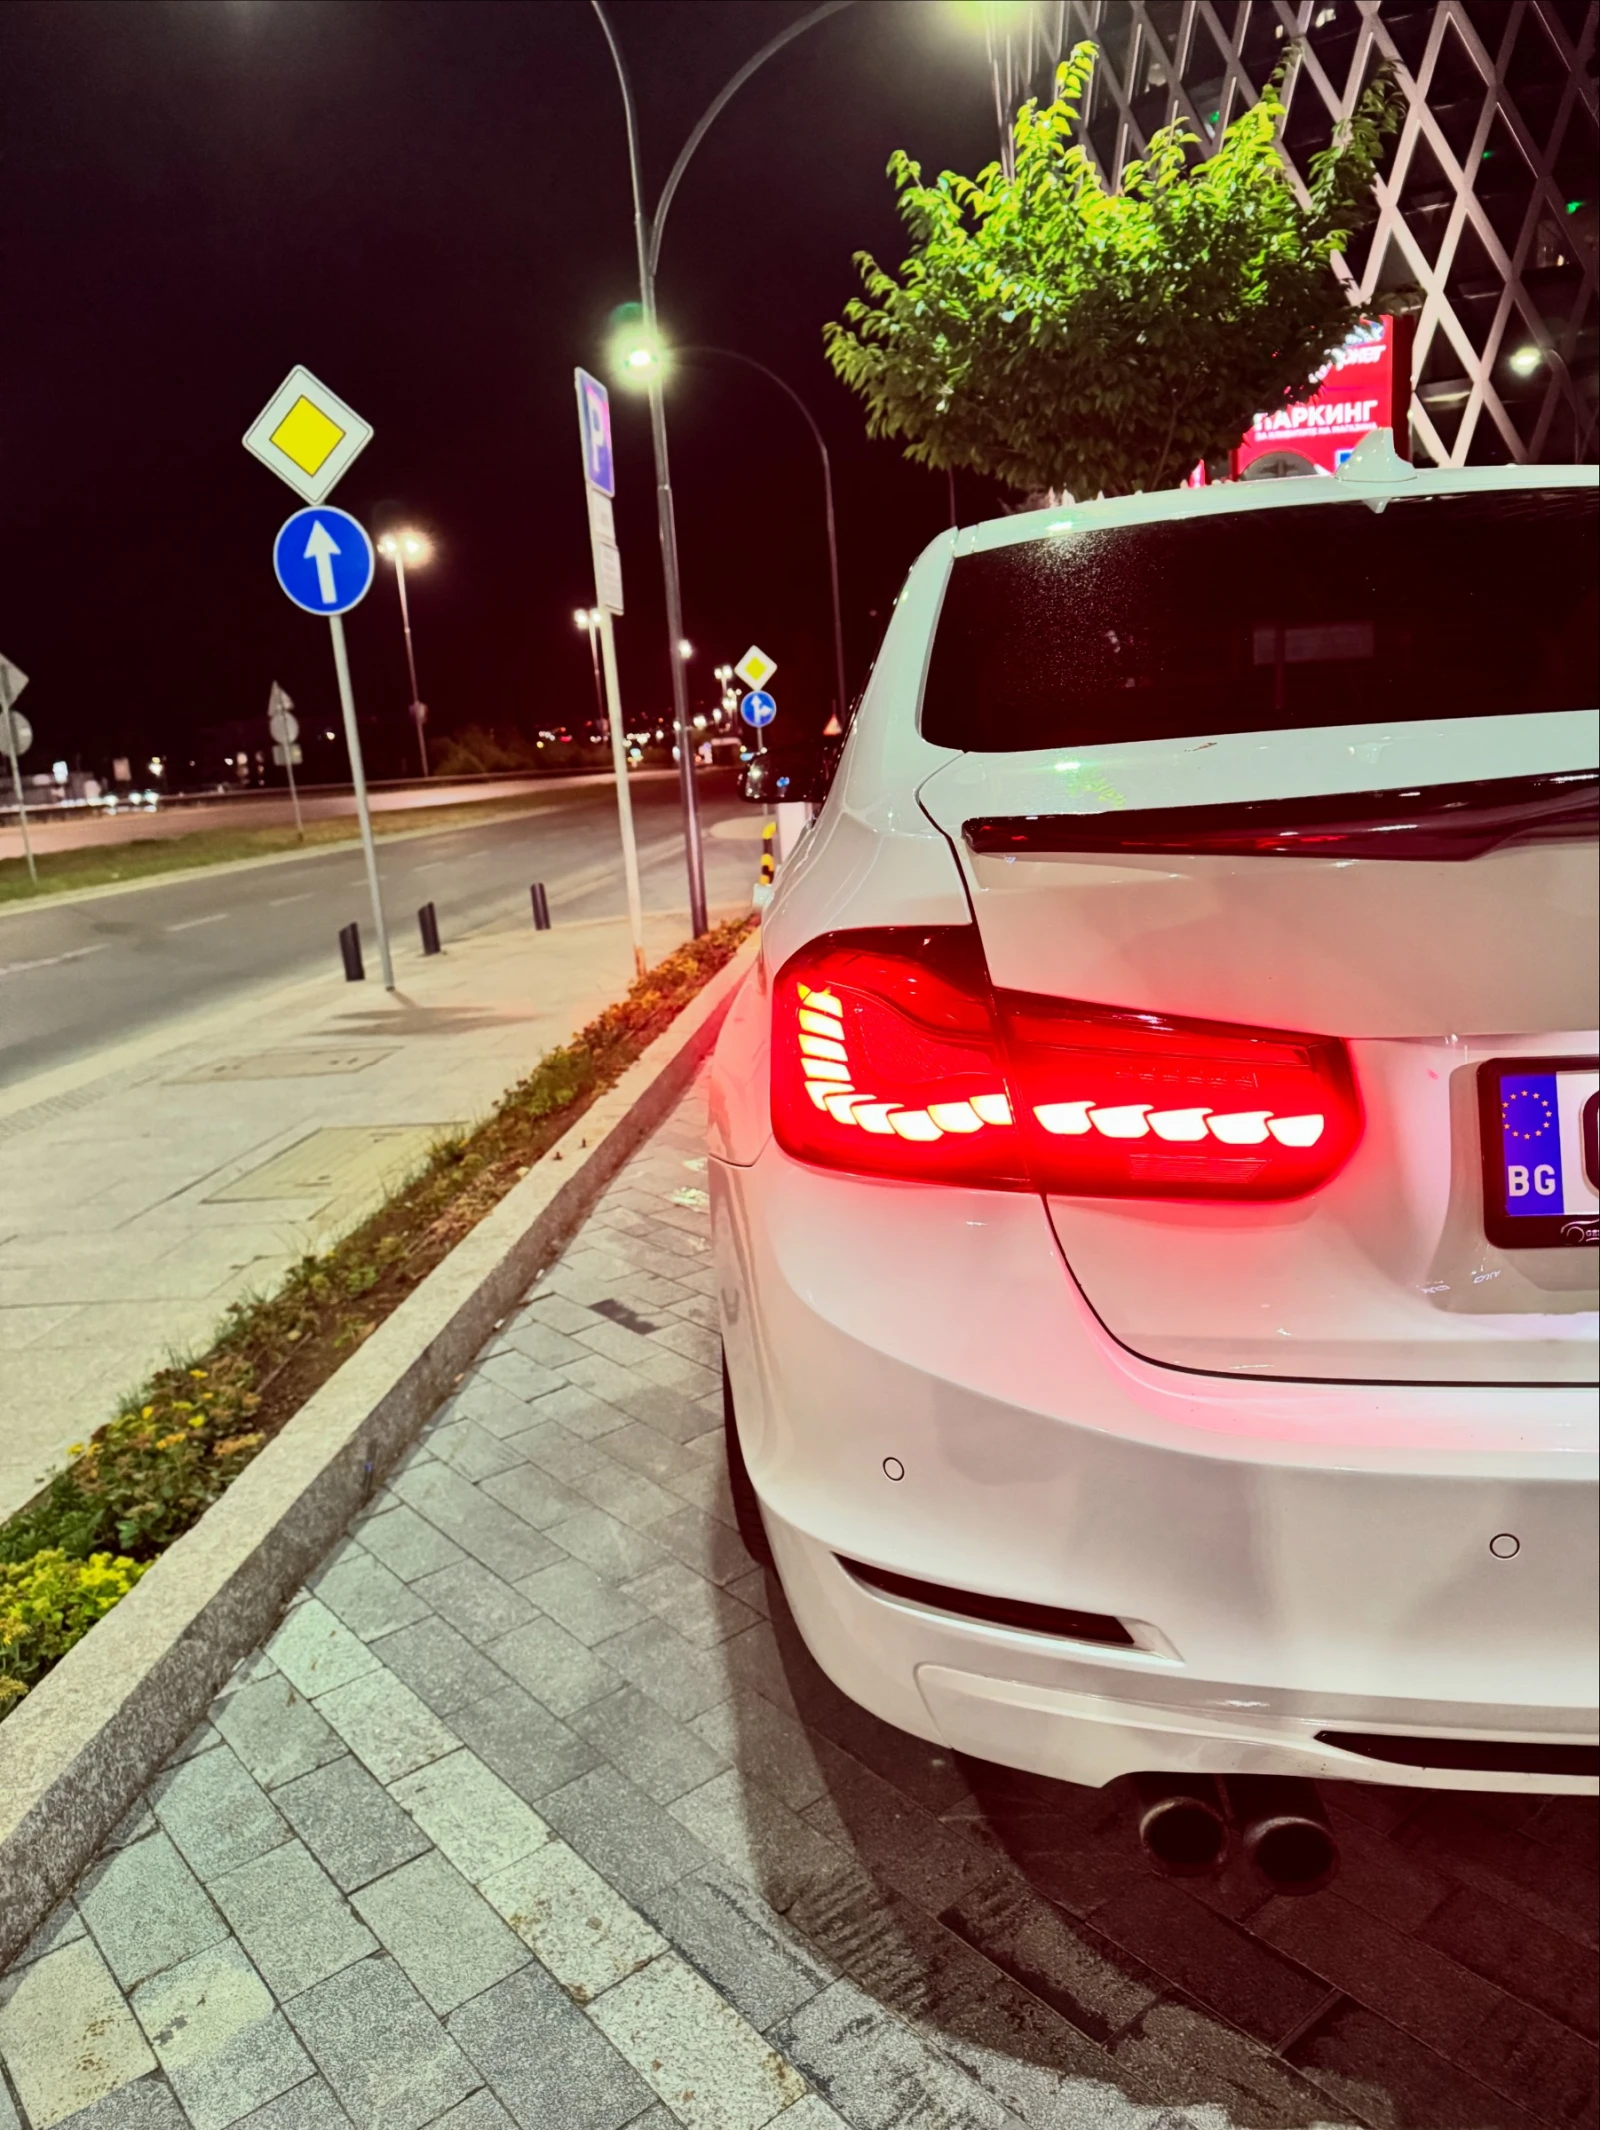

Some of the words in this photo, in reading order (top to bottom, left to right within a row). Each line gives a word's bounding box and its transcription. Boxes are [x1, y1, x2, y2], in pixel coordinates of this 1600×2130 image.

[586, 385, 606, 473] P
[1253, 400, 1378, 431] ПАРКИНГ
[1508, 1164, 1556, 1197] BG
